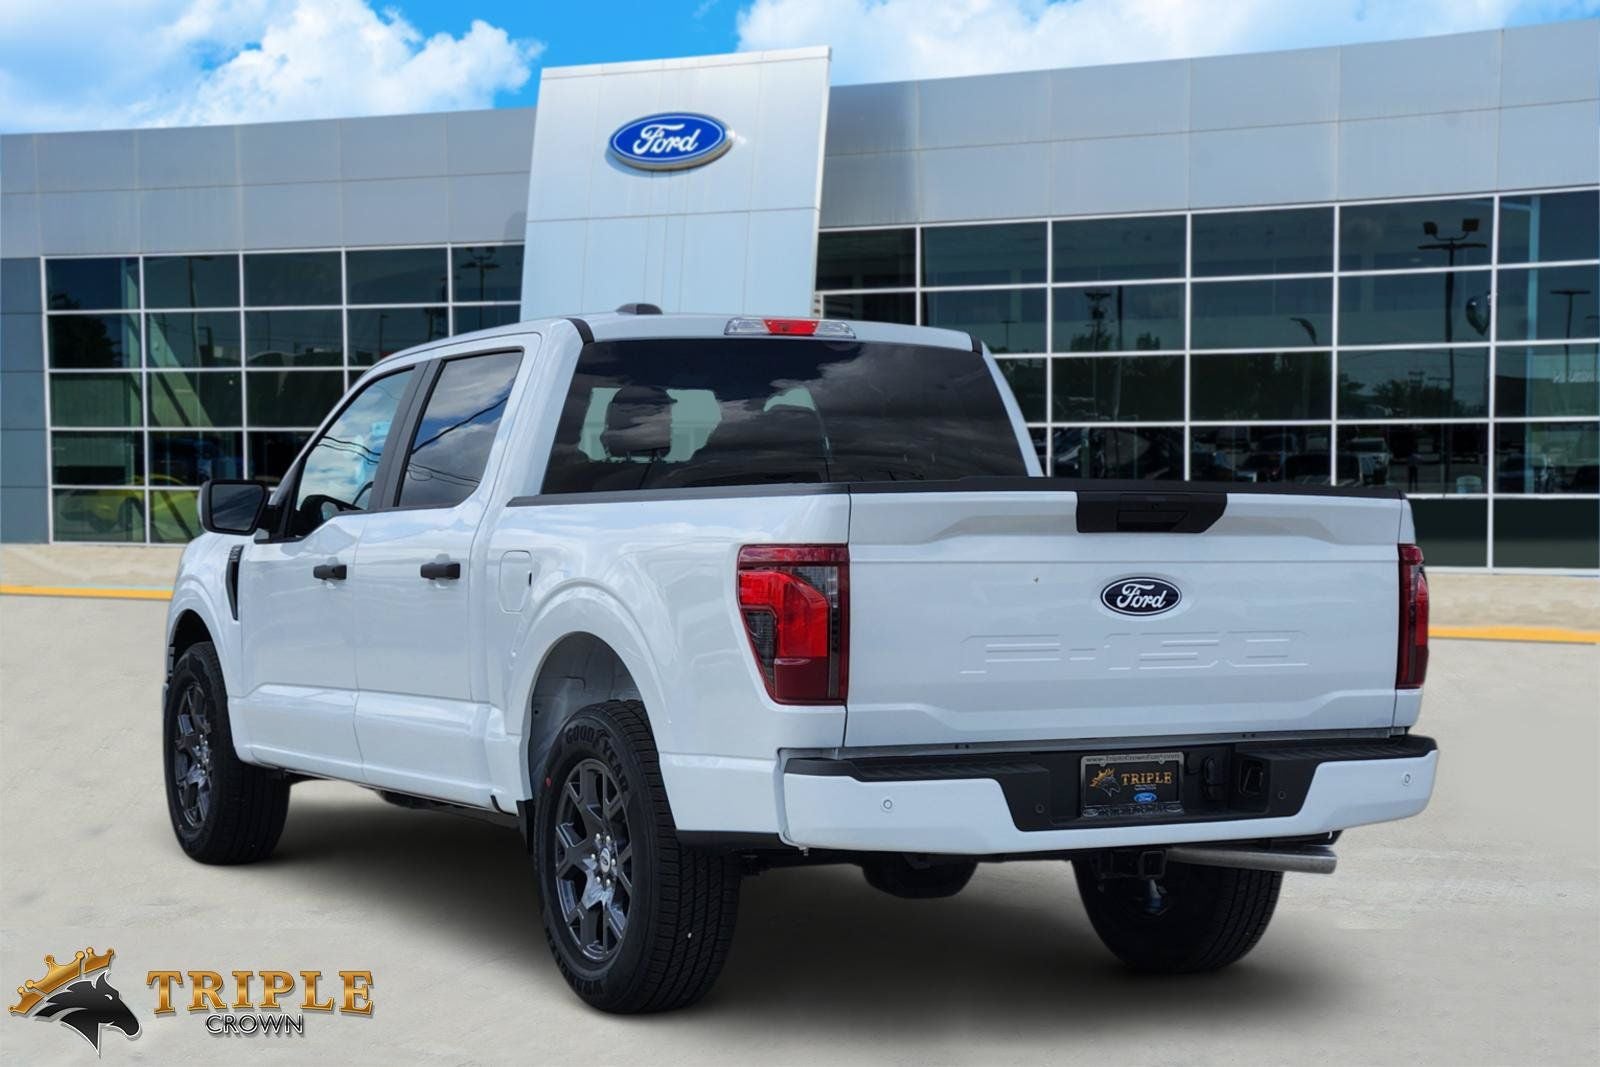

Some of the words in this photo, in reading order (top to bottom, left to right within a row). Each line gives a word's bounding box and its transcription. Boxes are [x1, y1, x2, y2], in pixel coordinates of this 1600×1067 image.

[632, 123, 702, 154] Ford
[1116, 583, 1167, 609] Ford
[960, 630, 1308, 674] F-150
[1121, 771, 1173, 785] TRIPLE
